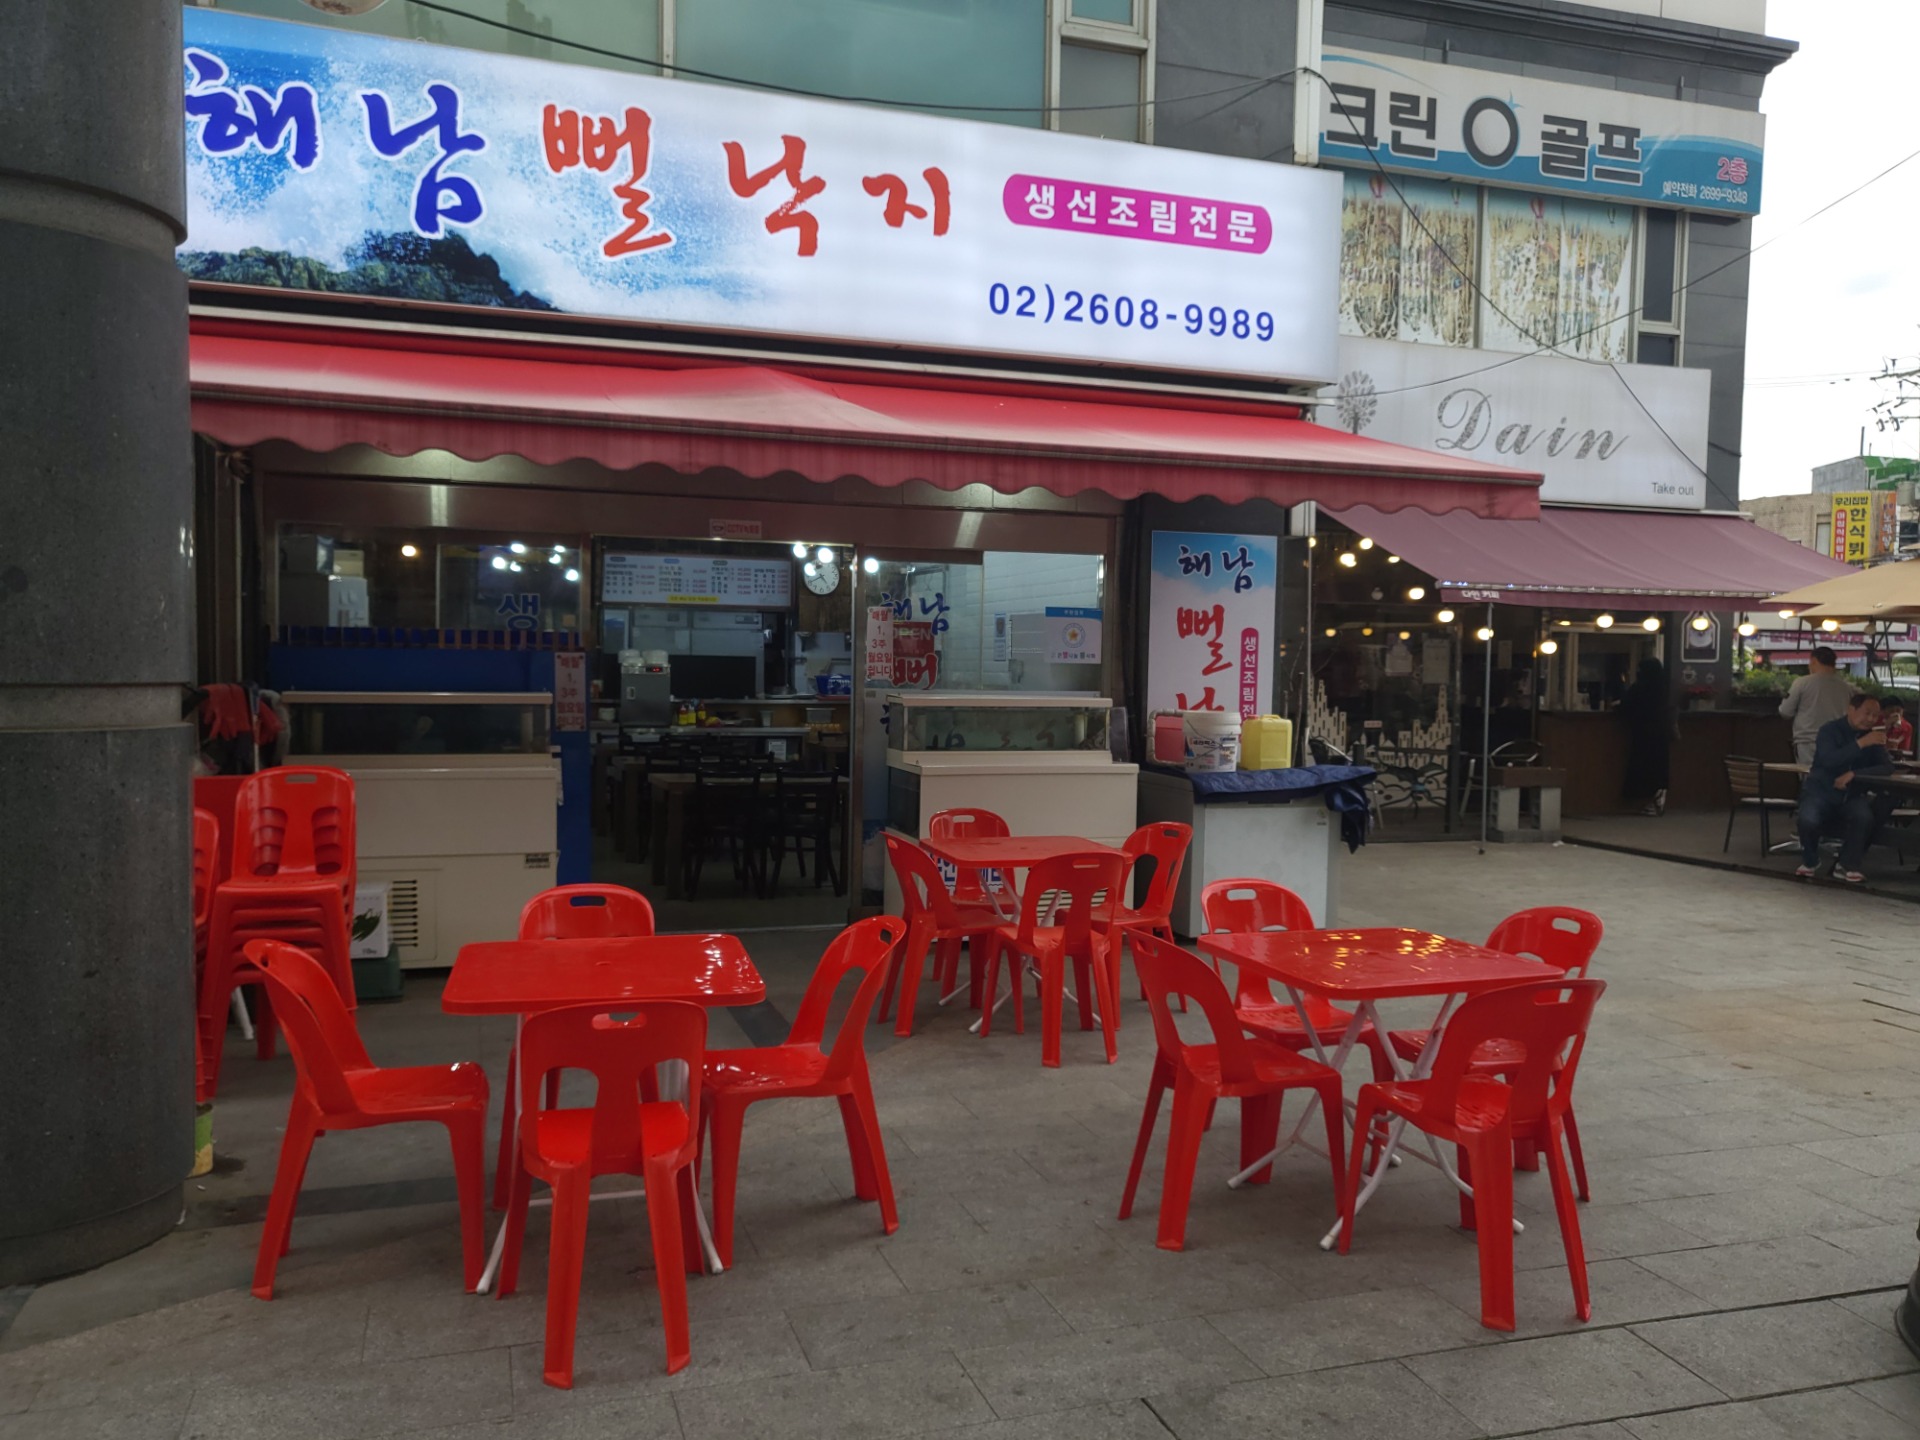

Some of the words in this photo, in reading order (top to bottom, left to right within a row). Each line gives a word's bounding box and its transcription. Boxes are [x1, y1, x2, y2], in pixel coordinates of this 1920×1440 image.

[1326, 82, 1437, 158] 크린
[1540, 114, 1642, 183] 골프
[1717, 156, 1748, 184] 2층
[1663, 181, 1697, 198] 예약전화
[1024, 183, 1257, 244] 생선조림전문
[989, 283, 1274, 342] 02)2608-9989
[1435, 387, 1630, 461] Dain
[1651, 482, 1675, 494] Take
[1177, 544, 1254, 593] 해남
[497, 593, 540, 631] 생
[872, 611, 888, 621] 매월
[868, 652, 892, 663] 월요일
[872, 639, 887, 648] 3주
[867, 665, 892, 676] 쉽니다
